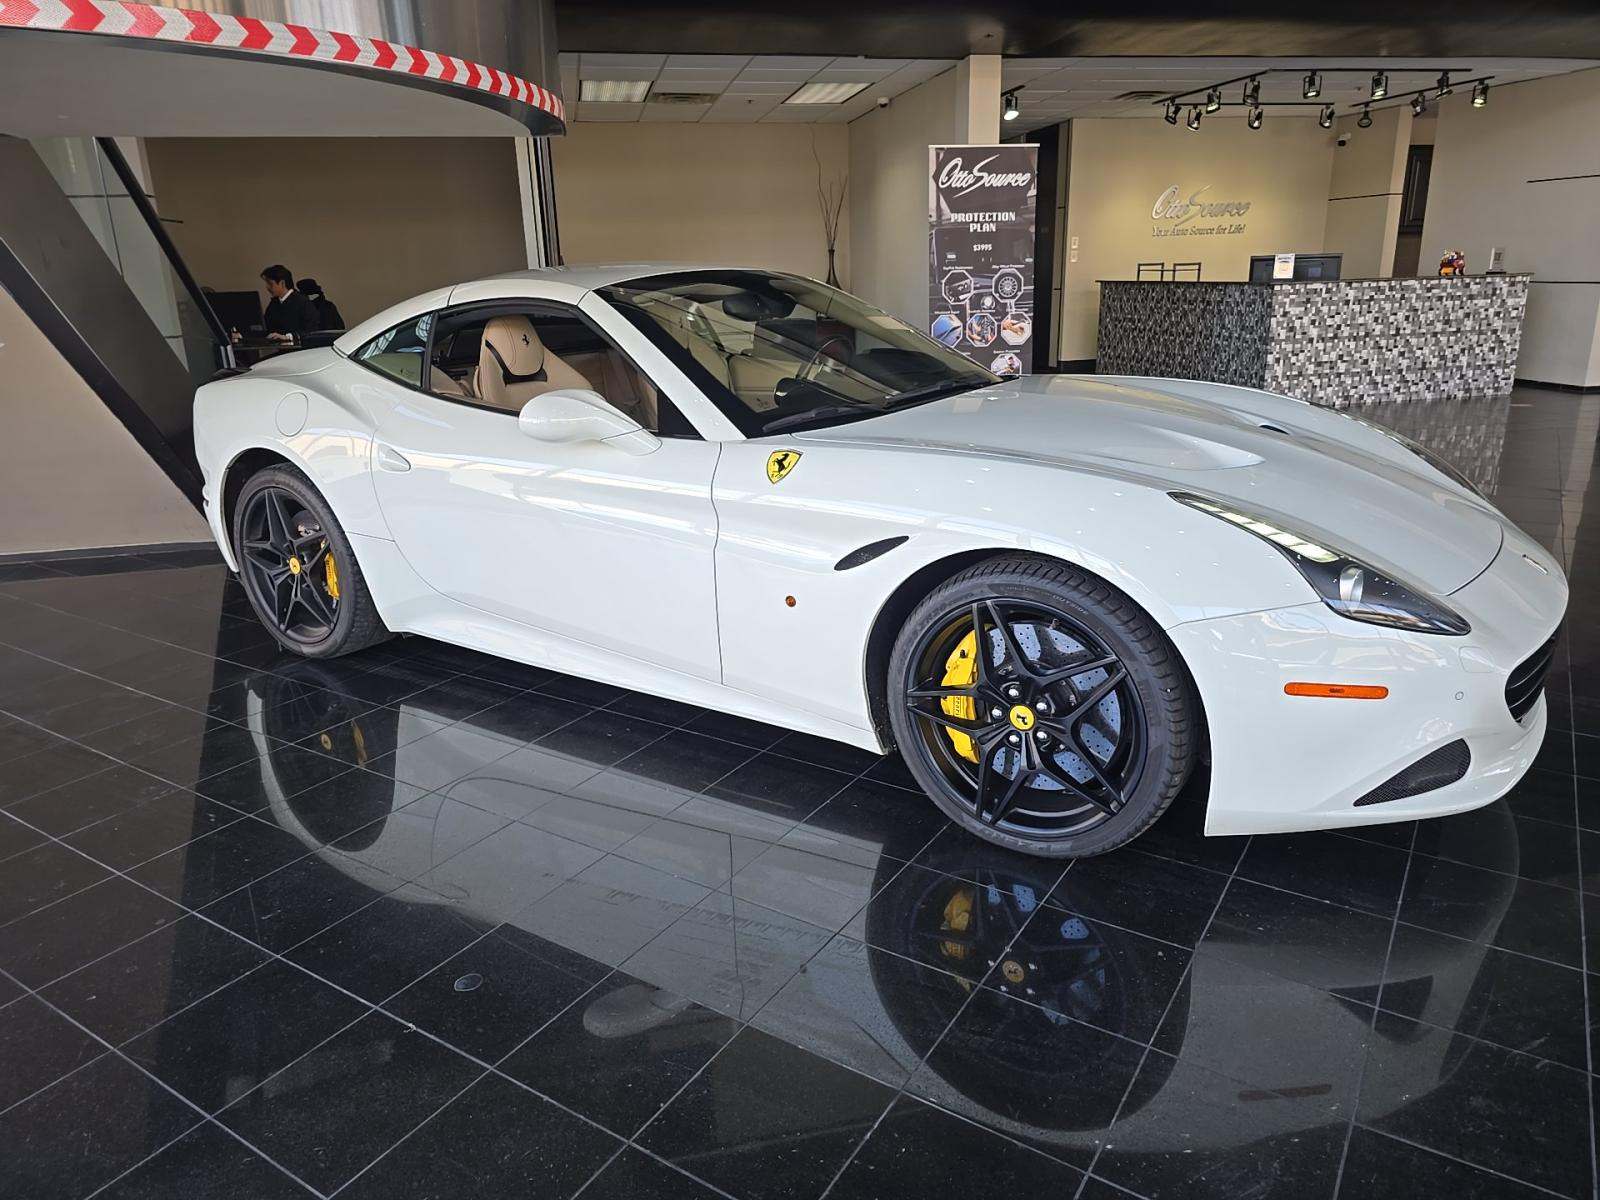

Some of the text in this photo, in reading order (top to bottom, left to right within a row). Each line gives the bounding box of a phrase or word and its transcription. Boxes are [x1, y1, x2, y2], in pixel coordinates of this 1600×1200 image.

[950, 212, 1016, 222] PROTECTION
[969, 223, 997, 232] PLAN
[1170, 226, 1189, 236] Auto
[1189, 225, 1214, 235] Source
[1215, 225, 1227, 234] for
[1227, 224, 1246, 234] Life!
